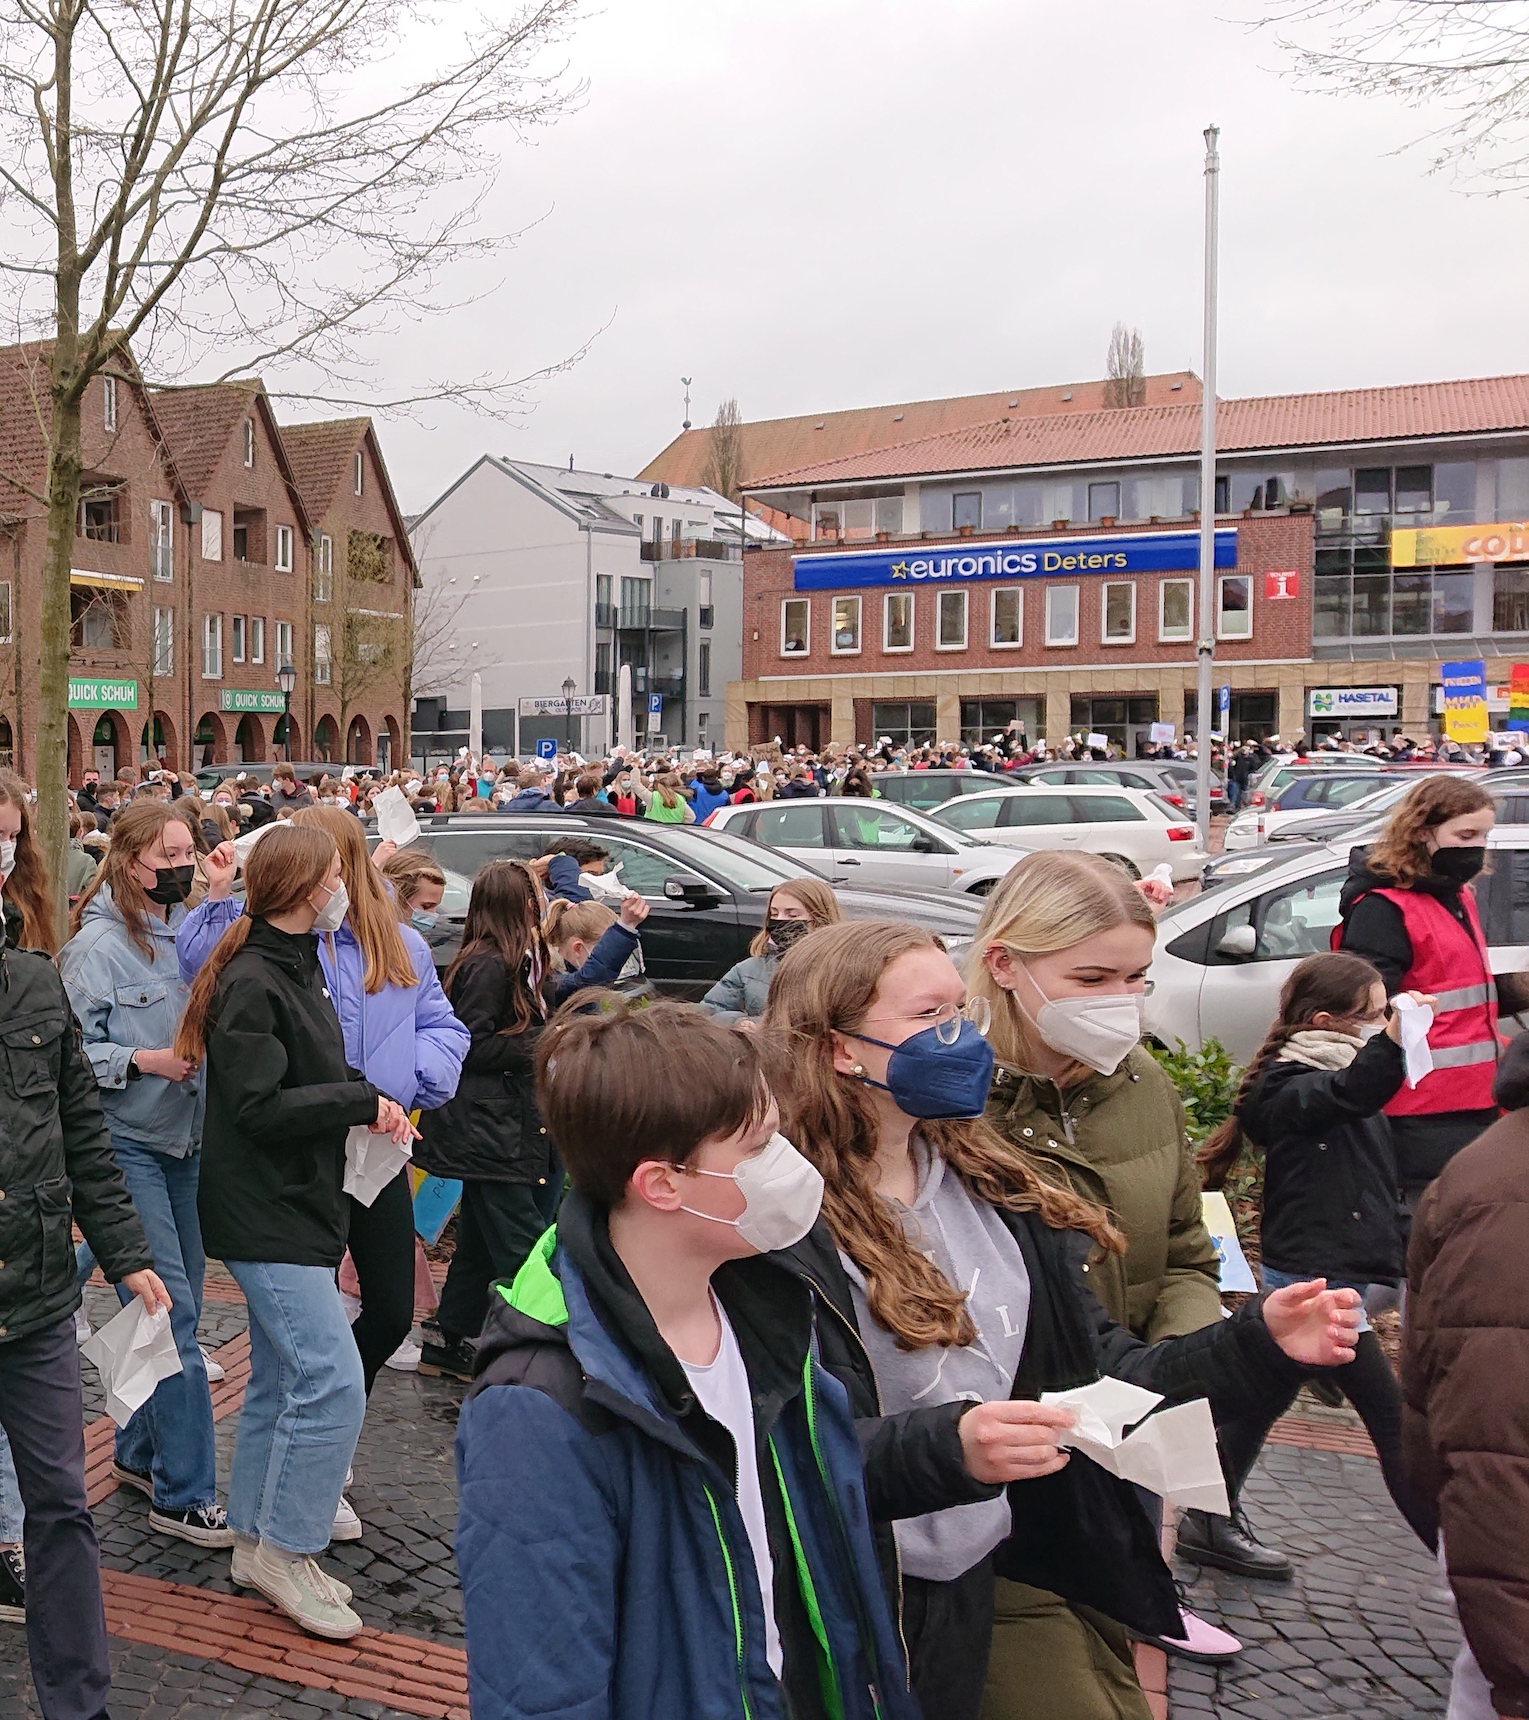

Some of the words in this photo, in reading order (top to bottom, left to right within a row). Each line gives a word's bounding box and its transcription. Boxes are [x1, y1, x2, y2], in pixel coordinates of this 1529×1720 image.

[910, 550, 1037, 579] euronics
[1044, 552, 1128, 572] Deters
[101, 685, 134, 701] SCHUH
[235, 693, 258, 707] QUICK
[261, 694, 285, 708] SCHUH
[1338, 692, 1393, 703] HASETAL
[534, 699, 587, 708] BIERGATEN
[652, 696, 659, 711] P
[542, 742, 552, 757] P
